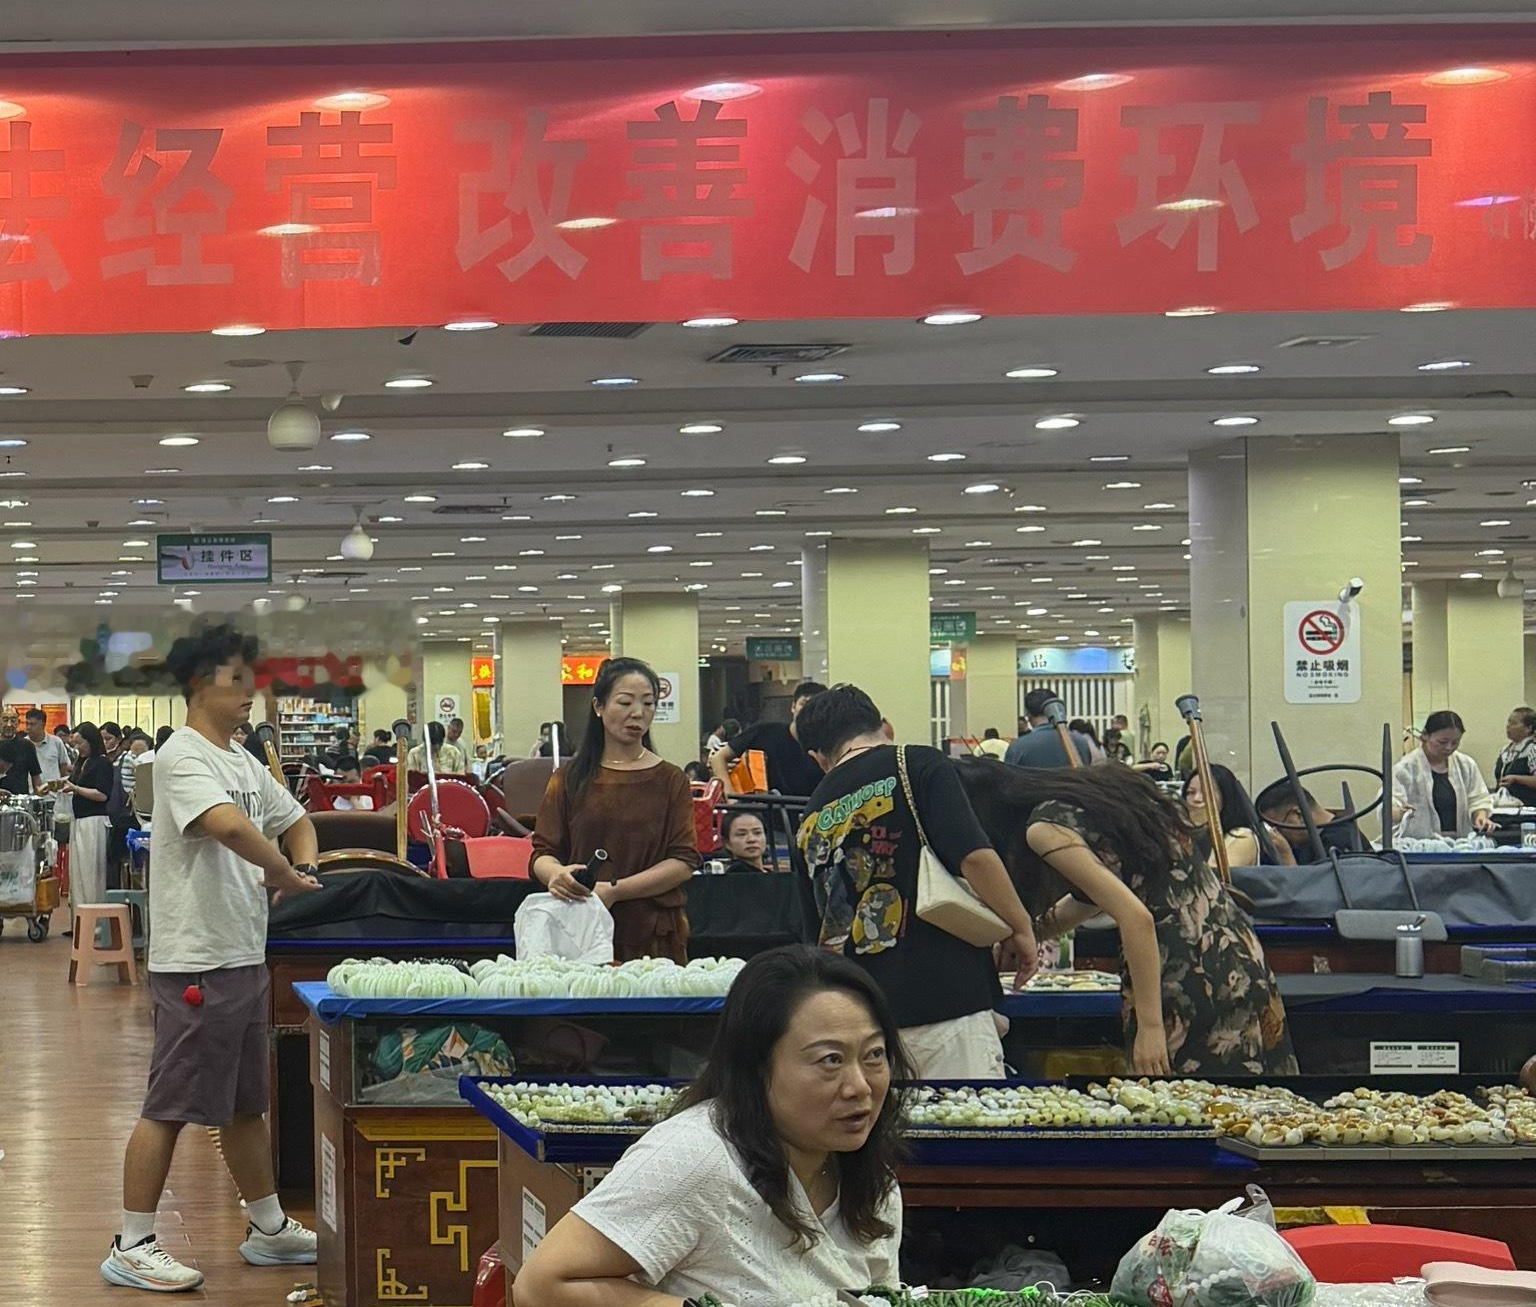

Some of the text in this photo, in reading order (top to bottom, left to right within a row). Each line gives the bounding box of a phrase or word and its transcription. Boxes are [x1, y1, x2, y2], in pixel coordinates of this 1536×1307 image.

[201, 550, 252, 562] 挂件区
[1296, 660, 1349, 671] 禁止吸烟
